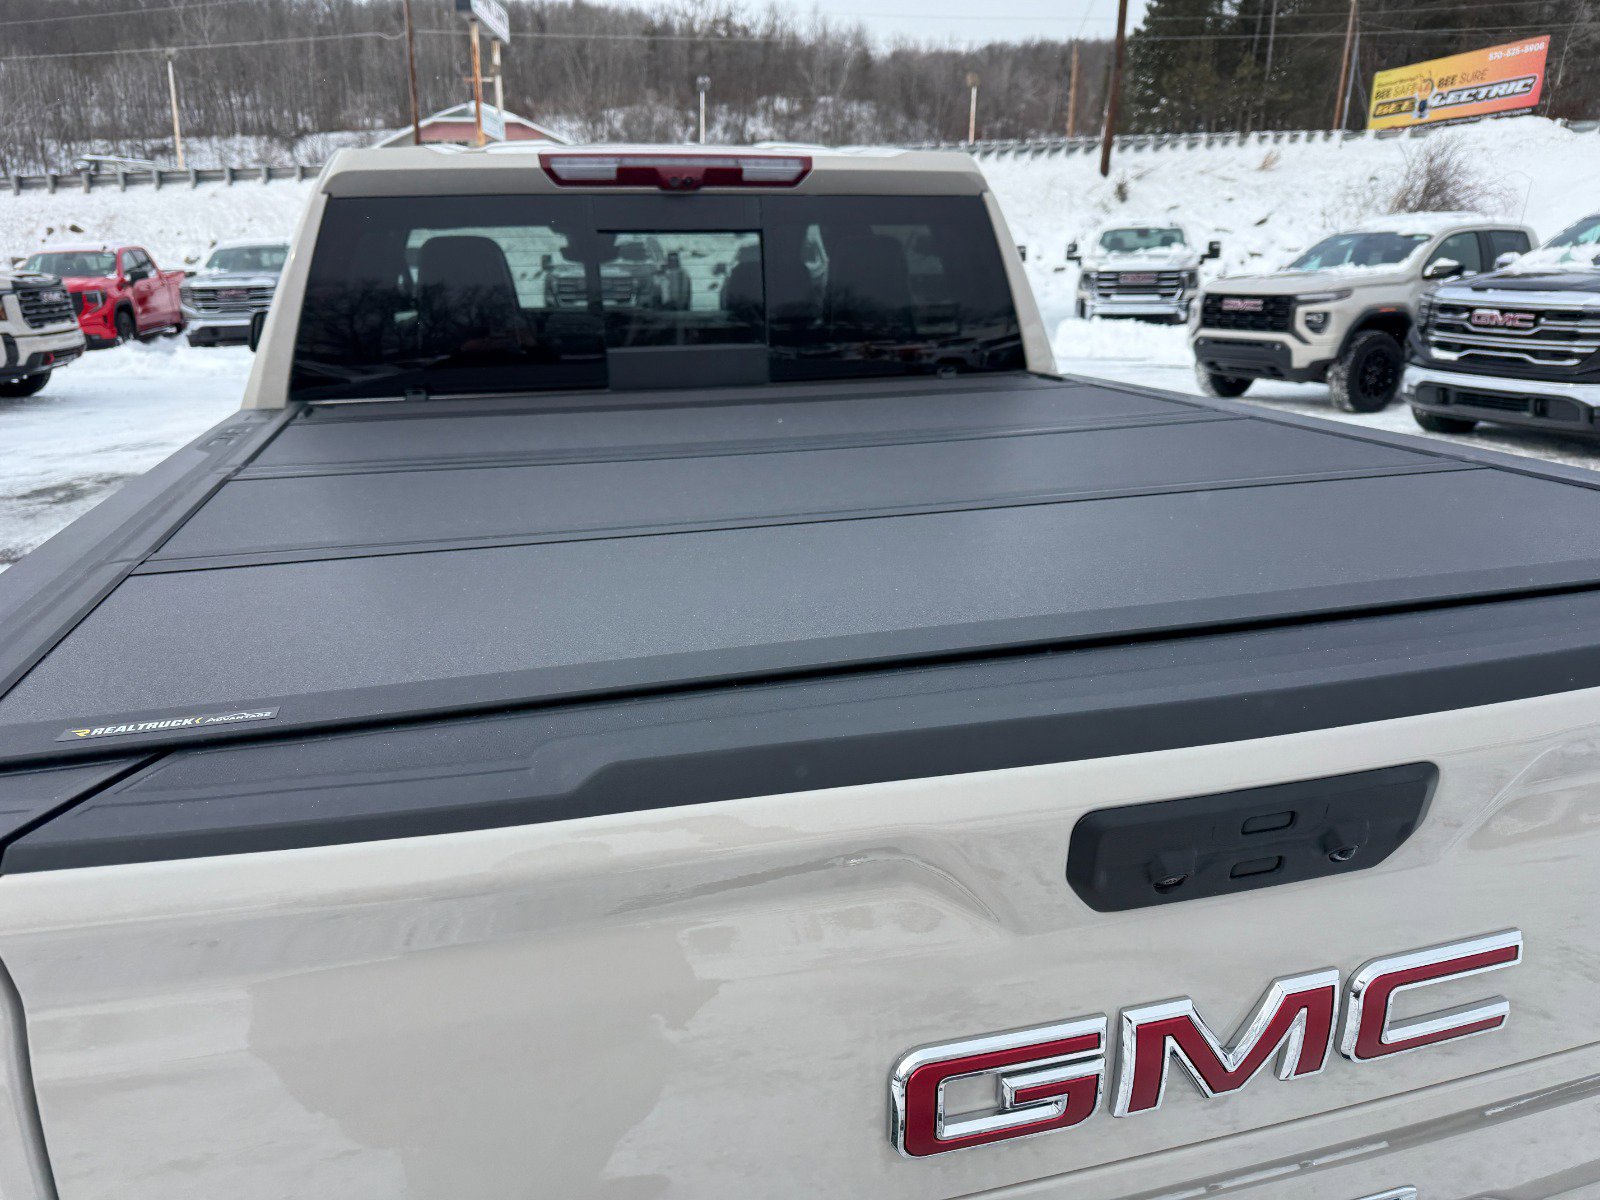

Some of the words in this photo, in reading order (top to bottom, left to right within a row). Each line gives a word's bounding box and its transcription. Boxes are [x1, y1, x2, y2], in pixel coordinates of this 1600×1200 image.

[1375, 88, 1391, 100] BEE
[1437, 74, 1459, 88] BEE
[1460, 67, 1489, 84] SURE
[1375, 100, 1414, 116] BEE
[1470, 310, 1536, 328] GMC
[90, 718, 196, 736] REALTRUCK
[204, 711, 272, 724] ADVANTAGE
[891, 927, 1524, 1159] GMC
